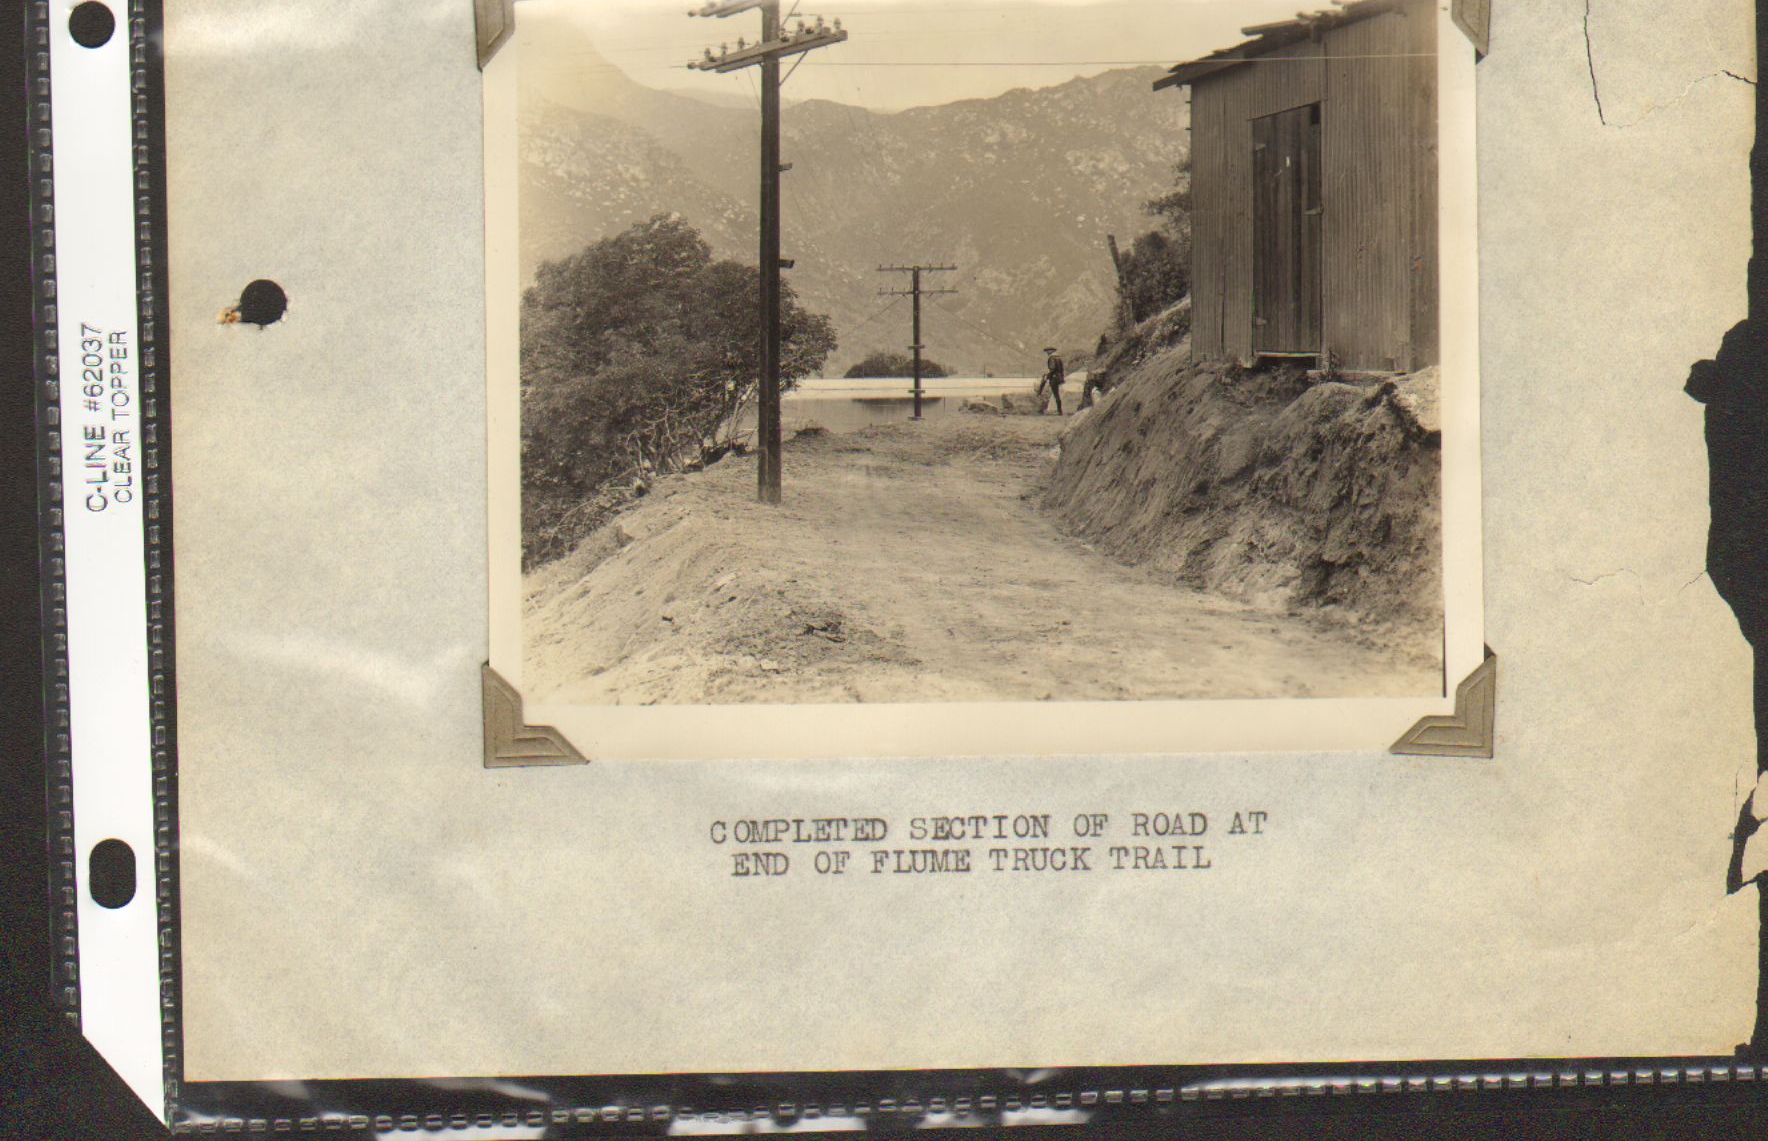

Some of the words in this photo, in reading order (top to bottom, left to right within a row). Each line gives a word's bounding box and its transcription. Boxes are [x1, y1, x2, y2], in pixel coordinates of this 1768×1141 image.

[80, 322, 104, 412] #62037
[109, 330, 130, 420] TOPPER
[84, 425, 109, 513] C-LINE
[112, 429, 133, 503] CLEAR
[710, 818, 888, 844] COMPLETED
[907, 814, 1051, 842] SECTION
[1071, 813, 1110, 838] OF
[1130, 812, 1208, 838] ROAD
[1226, 810, 1269, 836] AT
[730, 852, 789, 878] END
[813, 851, 850, 875] OF
[870, 848, 972, 874] FLUME
[988, 847, 1094, 872] TRUCK
[1108, 845, 1213, 870] TRAIL
